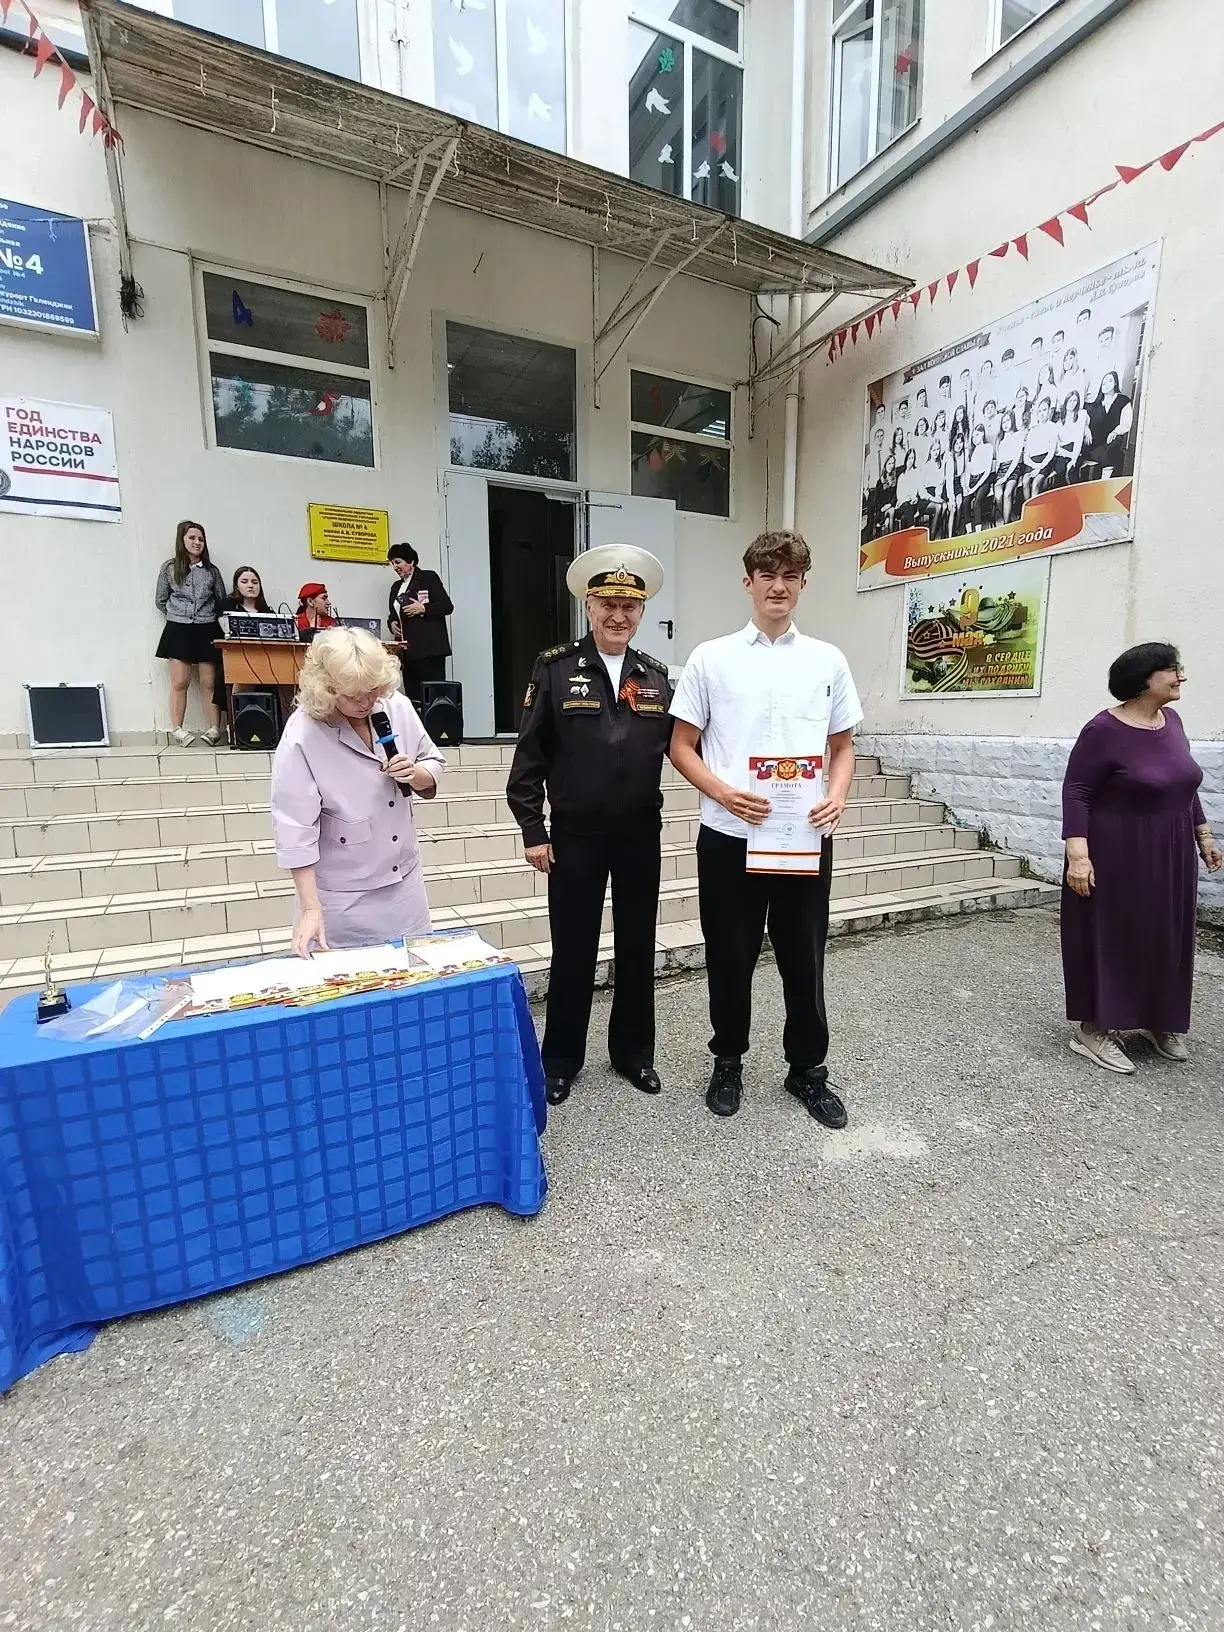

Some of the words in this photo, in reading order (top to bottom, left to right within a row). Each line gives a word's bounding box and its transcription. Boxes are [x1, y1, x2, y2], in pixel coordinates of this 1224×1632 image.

[5, 406, 43, 424] ГОД
[7, 421, 102, 445] ЕДИНСТВА
[9, 436, 95, 457] НАРОДОВ
[11, 450, 85, 470] РОССИИ
[903, 542, 979, 570] Выпускники
[980, 531, 1014, 553] 2021
[1016, 525, 1053, 545] года
